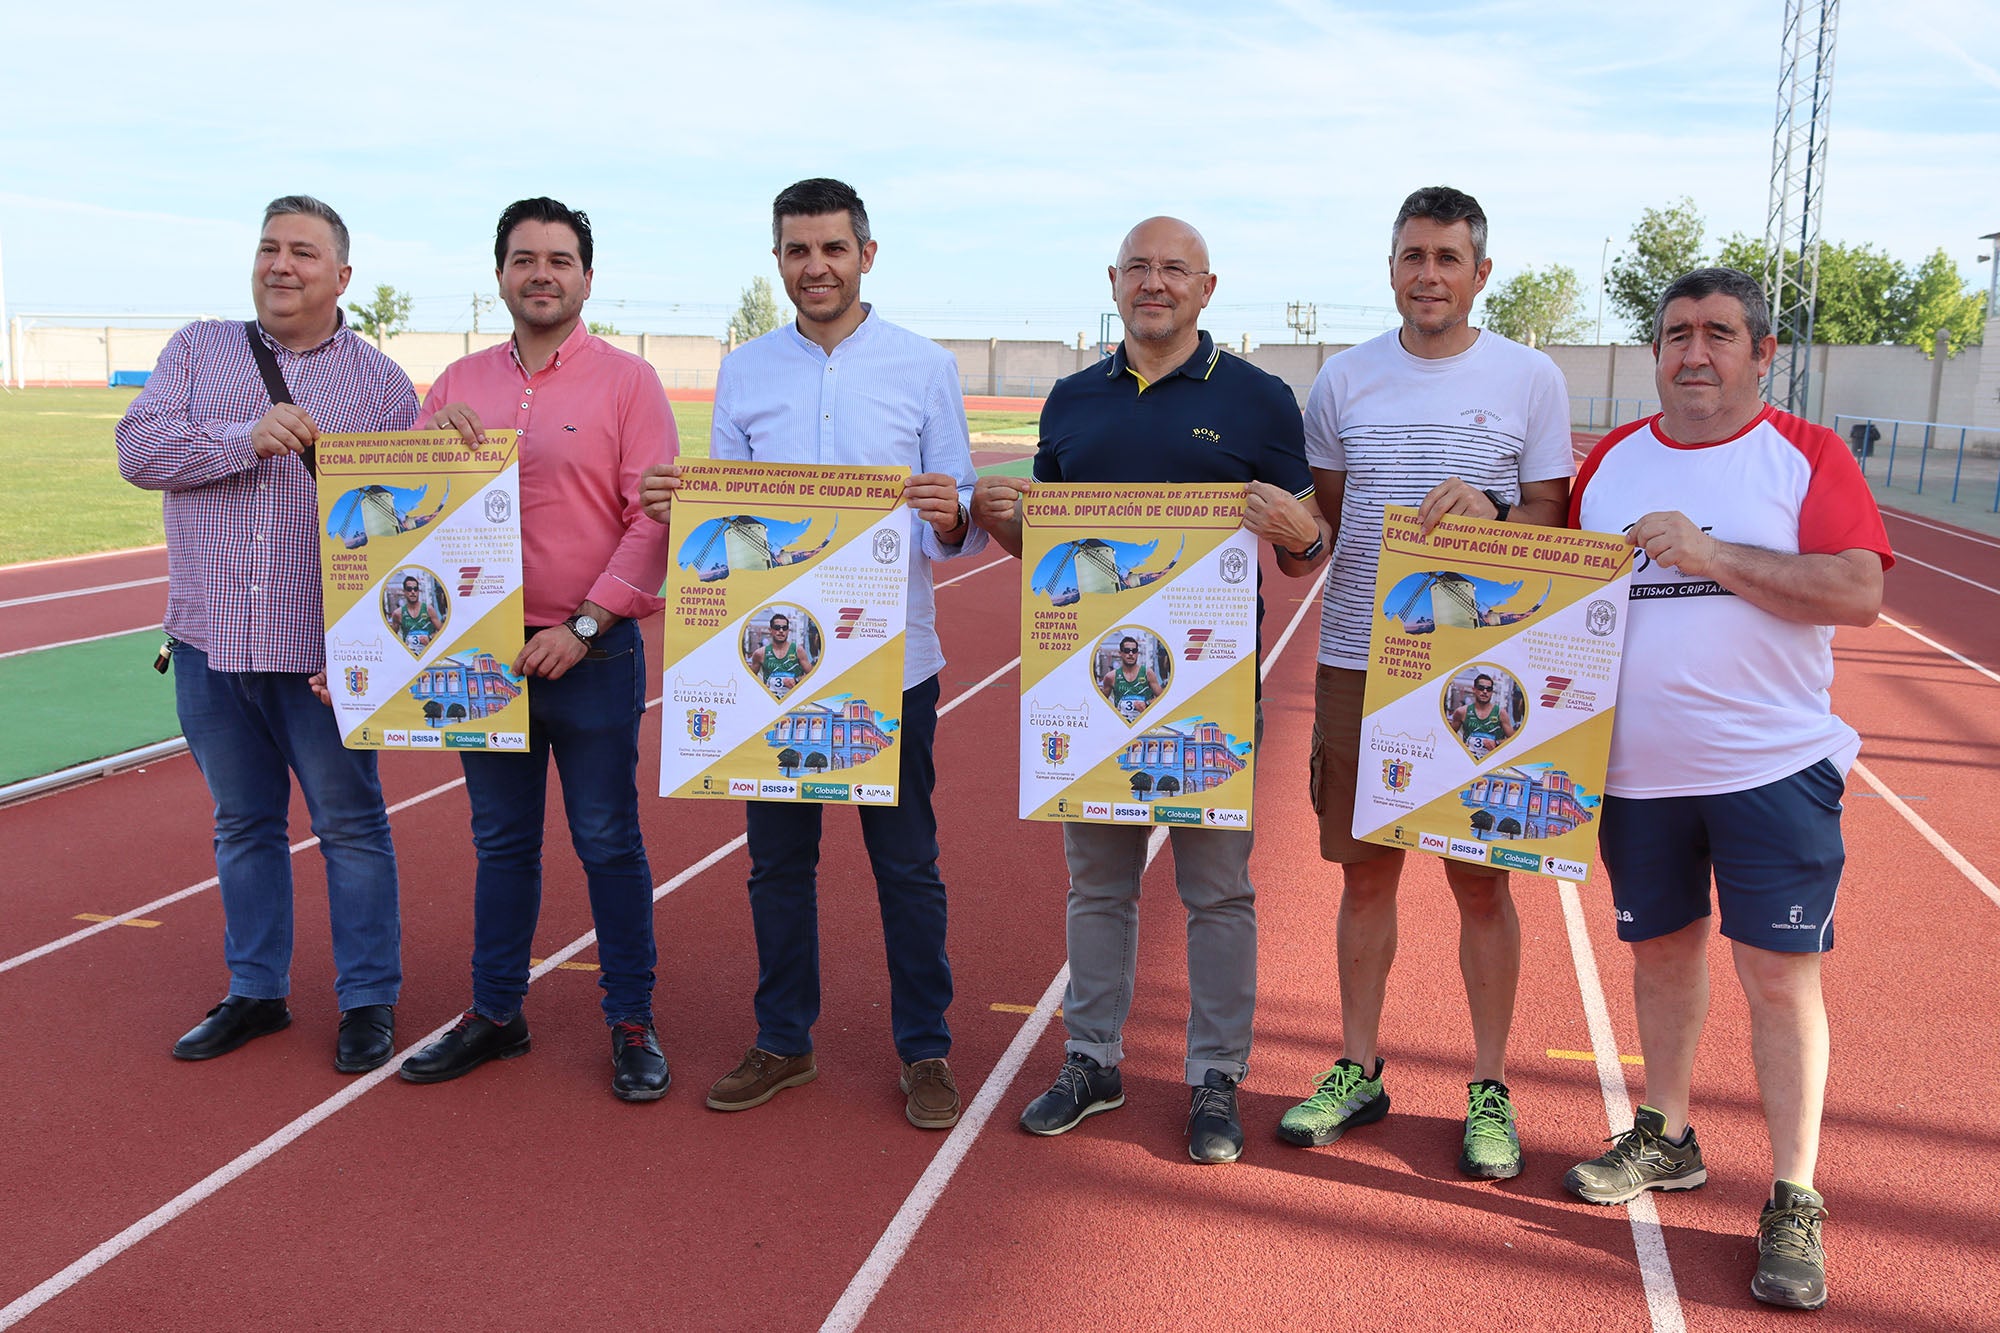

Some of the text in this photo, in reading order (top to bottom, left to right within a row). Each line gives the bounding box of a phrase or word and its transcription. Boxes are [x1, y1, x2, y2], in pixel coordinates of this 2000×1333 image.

[1192, 428, 1221, 441] BOSS
[446, 437, 507, 445] ATLSMO
[319, 450, 505, 465] EXCMA. DIPUTACIÓN DE CIUDAD REAL
[692, 466, 720, 474] GRAN
[722, 467, 764, 476] PREMIO
[767, 469, 818, 478] NACIONAL
[821, 471, 835, 479] DE
[837, 472, 901, 481] ATLETISMO
[726, 481, 795, 494] DIPUTACIÓN
[800, 485, 814, 495] DE
[819, 485, 862, 497] CIUDAD
[867, 487, 897, 499] REAL
[1027, 502, 1244, 517] EXCMA. DIPUTACIÓN DE CIUDAD REAL
[1388, 513, 1400, 522] III
[1477, 526, 1535, 541] NACIONAL
[1535, 532, 1553, 543] DE
[1552, 535, 1624, 552] ATLETISMO
[1386, 527, 1618, 570] EXCMA. DIPUTACIÓN DE CIUDAD REAL
[681, 587, 714, 595] CAMPO
[1630, 584, 1730, 597] LETISMO CRIPTAN
[681, 597, 725, 606] CRIPTANA
[676, 607, 685, 615] 21
[700, 608, 727, 616] MAYO
[1035, 622, 1076, 630] CRIPTANA
[1384, 636, 1431, 650] CAMPO DE
[1384, 647, 1430, 660] CRIPTANA
[1379, 656, 1431, 671] 21 DE MAYO
[1388, 668, 1422, 680] DE 2022
[674, 695, 710, 703] CIUDAD
[1568, 699, 1593, 707] CASTILLA
[456, 736, 485, 744] Globalcaja
[1371, 743, 1433, 759] CIUDAD REAL
[733, 783, 754, 791] AON
[814, 787, 847, 796] Globalcaja
[1087, 806, 1107, 814] AON
[1167, 811, 1200, 820] Globalcaja
[1422, 837, 1444, 848] AON
[1504, 853, 1539, 867] Globalcaja
